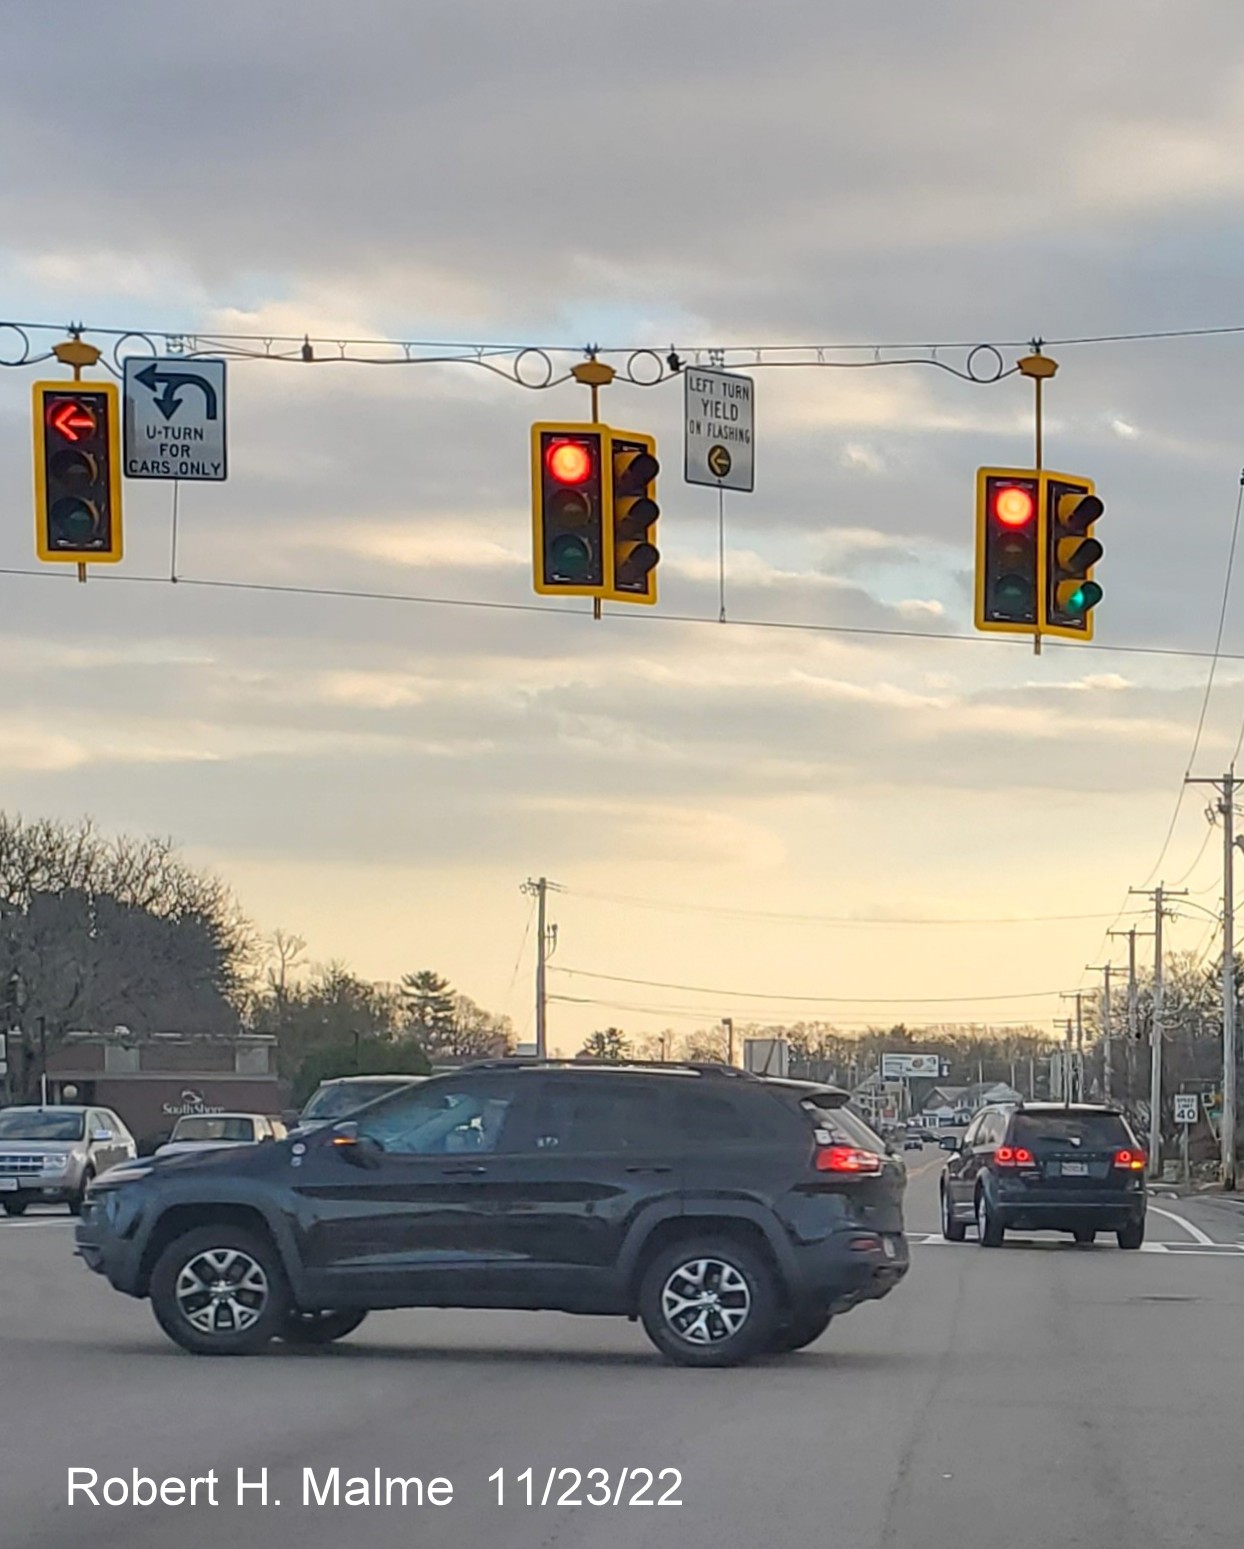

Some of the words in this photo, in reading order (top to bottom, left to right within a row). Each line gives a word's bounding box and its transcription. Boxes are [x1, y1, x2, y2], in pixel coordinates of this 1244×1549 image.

[689, 376, 714, 395] LEFT
[722, 382, 750, 401] TURN
[701, 398, 739, 421] YIELD
[146, 424, 204, 440] U-TURN
[690, 419, 701, 434] ON
[707, 422, 750, 444] FLASHING
[159, 443, 191, 458] FOR
[129, 459, 171, 475] CARS
[179, 461, 221, 476] ONLY
[1177, 1109, 1196, 1120] 40
